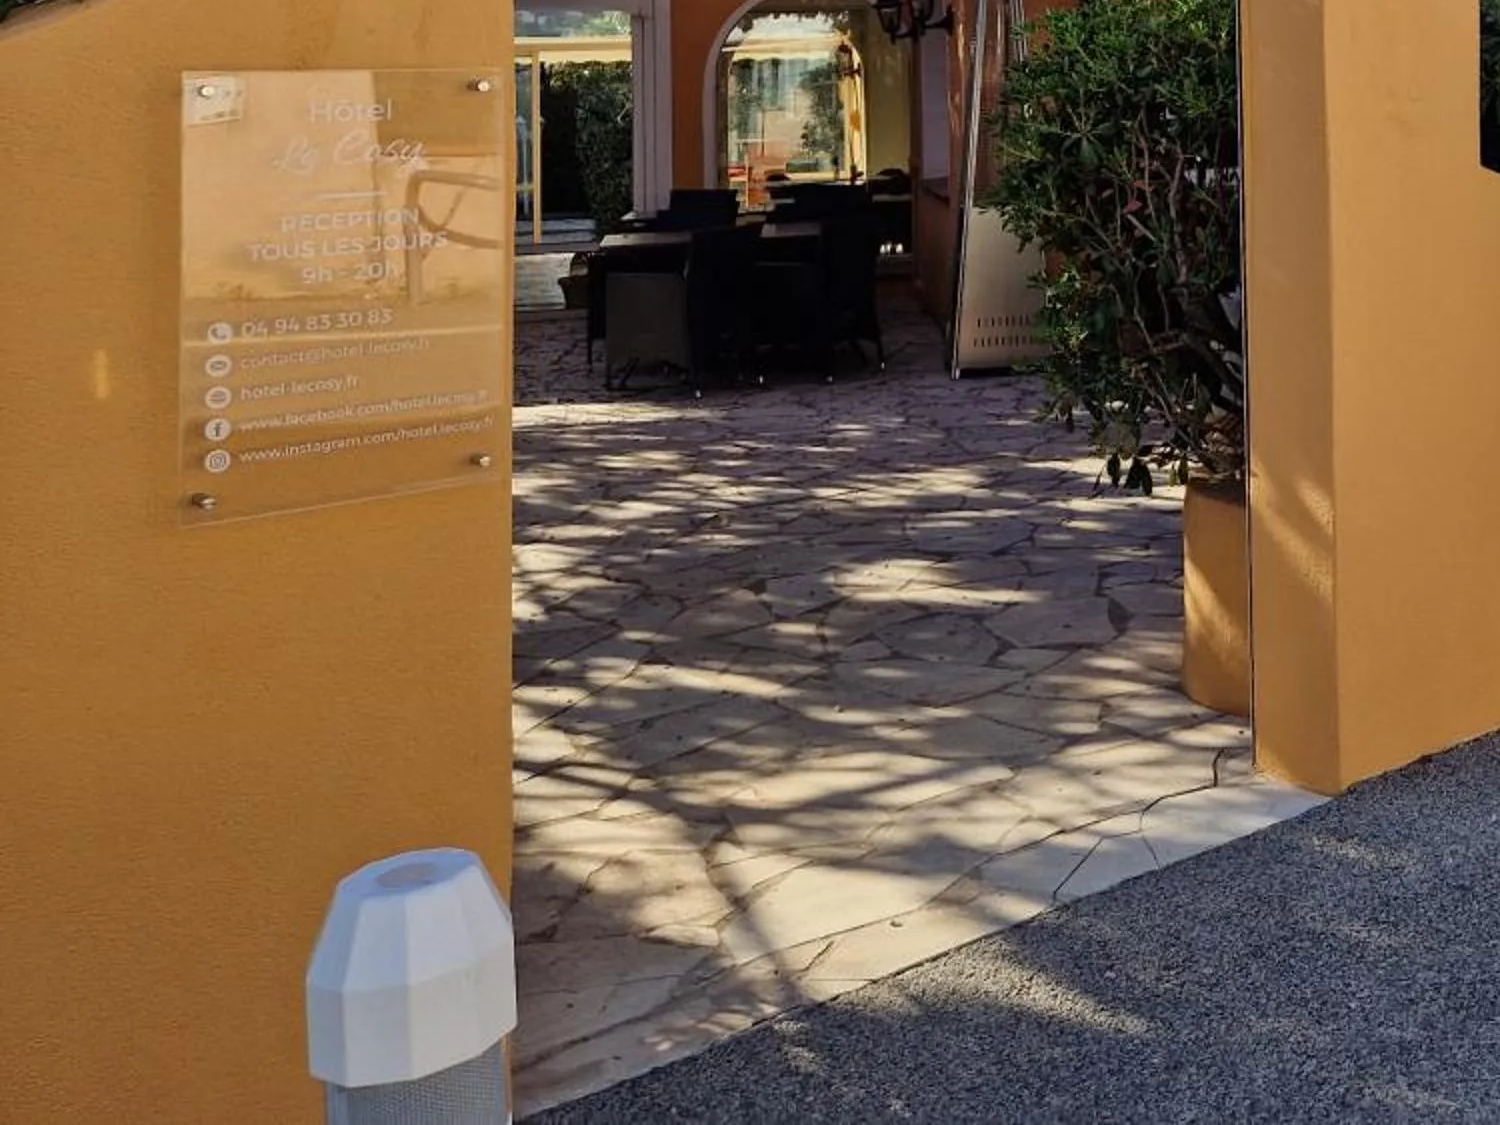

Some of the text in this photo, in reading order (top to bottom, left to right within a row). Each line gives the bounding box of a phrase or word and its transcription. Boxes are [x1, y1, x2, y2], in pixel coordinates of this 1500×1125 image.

[248, 230, 448, 262] TOUS LES JOURS
[302, 265, 333, 285] 9h
[353, 259, 399, 281] 20h
[241, 321, 268, 338] 04
[275, 316, 300, 335] 94
[335, 311, 363, 328] 30
